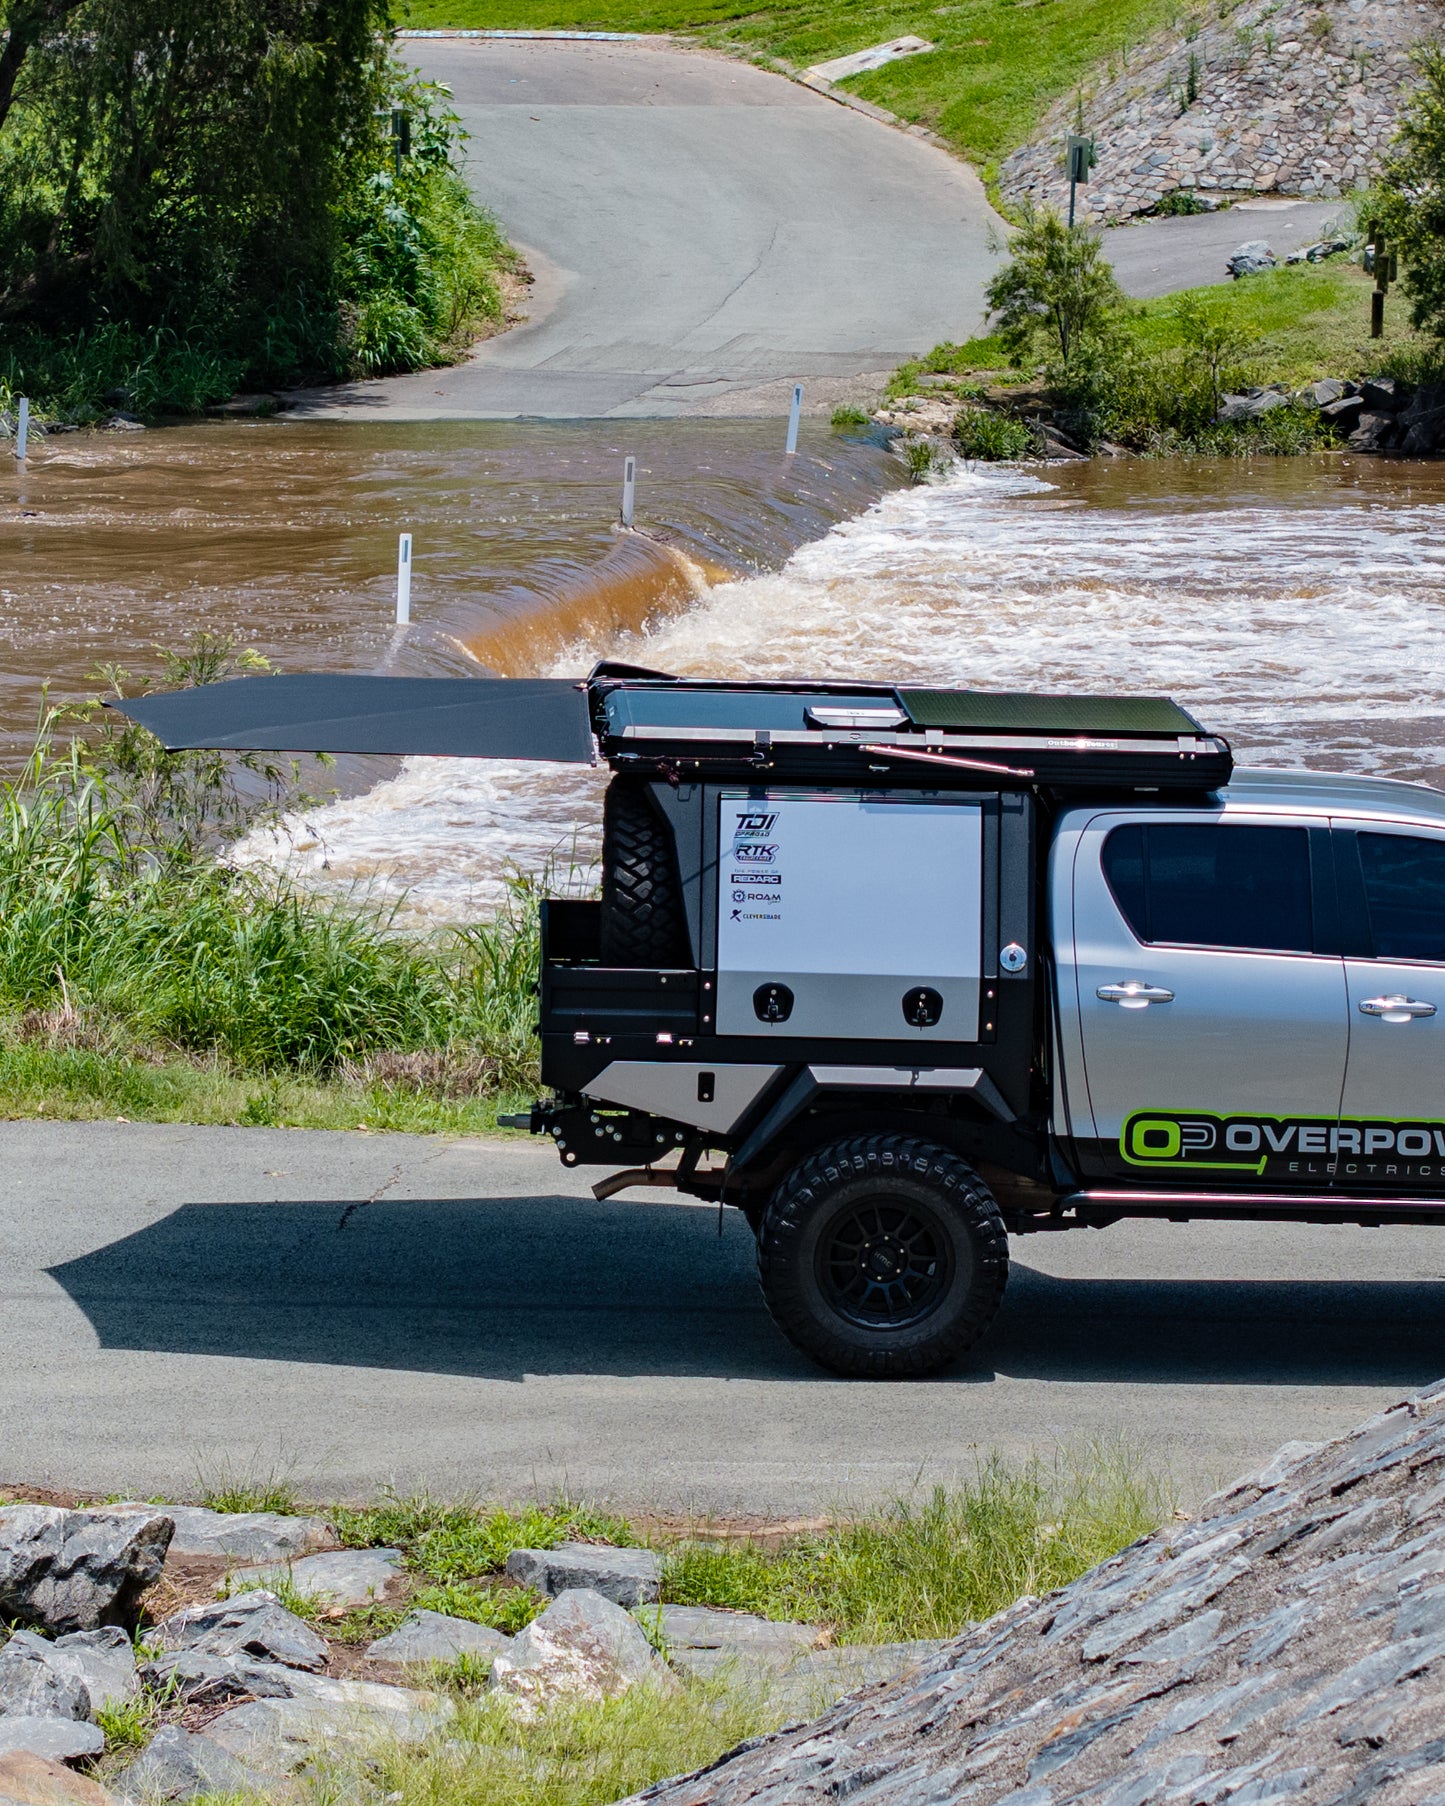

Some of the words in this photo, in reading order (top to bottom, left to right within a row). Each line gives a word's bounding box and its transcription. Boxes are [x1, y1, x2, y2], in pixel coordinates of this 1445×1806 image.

[736, 813, 776, 830] TDI
[736, 845, 776, 856] RTK
[733, 875, 779, 883] REDARC
[747, 893, 782, 901] ROAM
